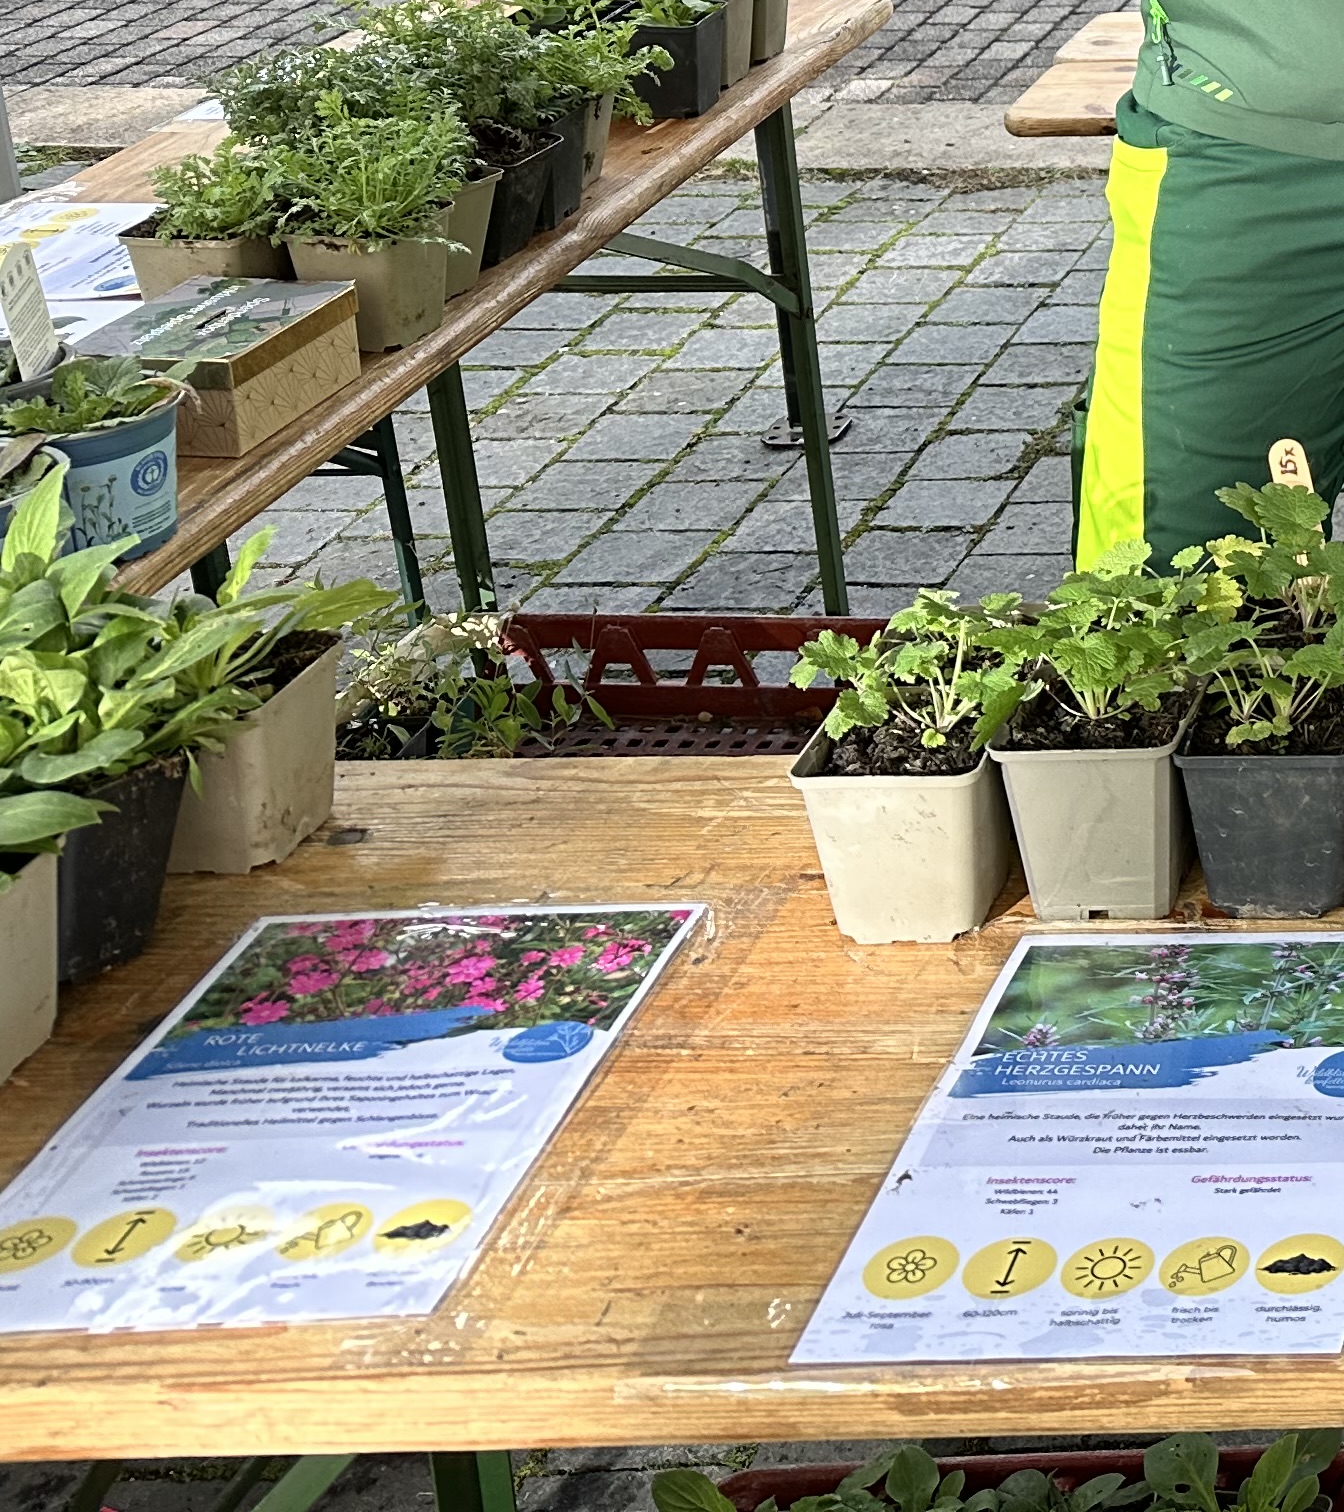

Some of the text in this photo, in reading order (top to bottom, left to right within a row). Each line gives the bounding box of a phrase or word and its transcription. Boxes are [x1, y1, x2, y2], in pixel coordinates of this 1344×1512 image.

[203, 1032, 265, 1047] ROTE
[236, 1041, 370, 1057] LICHTNELKE
[1002, 1050, 1089, 1063] ECHTES
[994, 1063, 1161, 1076] HERZGESPANN
[1001, 1077, 1122, 1087] Leonurus cardiaca
[962, 1113, 986, 1121] Eine
[987, 1113, 1041, 1121] heimische
[1043, 1113, 1082, 1121] Staude,
[1102, 1110, 1137, 1121] früher
[1137, 1113, 1171, 1121] gegen
[1173, 1113, 1266, 1121] Herzbeschwerden
[1267, 1113, 1322, 1122] eingesetzt
[1007, 1133, 1302, 1143] Auch als Würzkraut und Färbemittel eingesetzt worden.
[1092, 1146, 1209, 1154] Die Pflanze ist essbar.
[985, 1176, 1077, 1185] Insektenscore:
[1190, 1174, 1313, 1185] Gefährdungsstatus:
